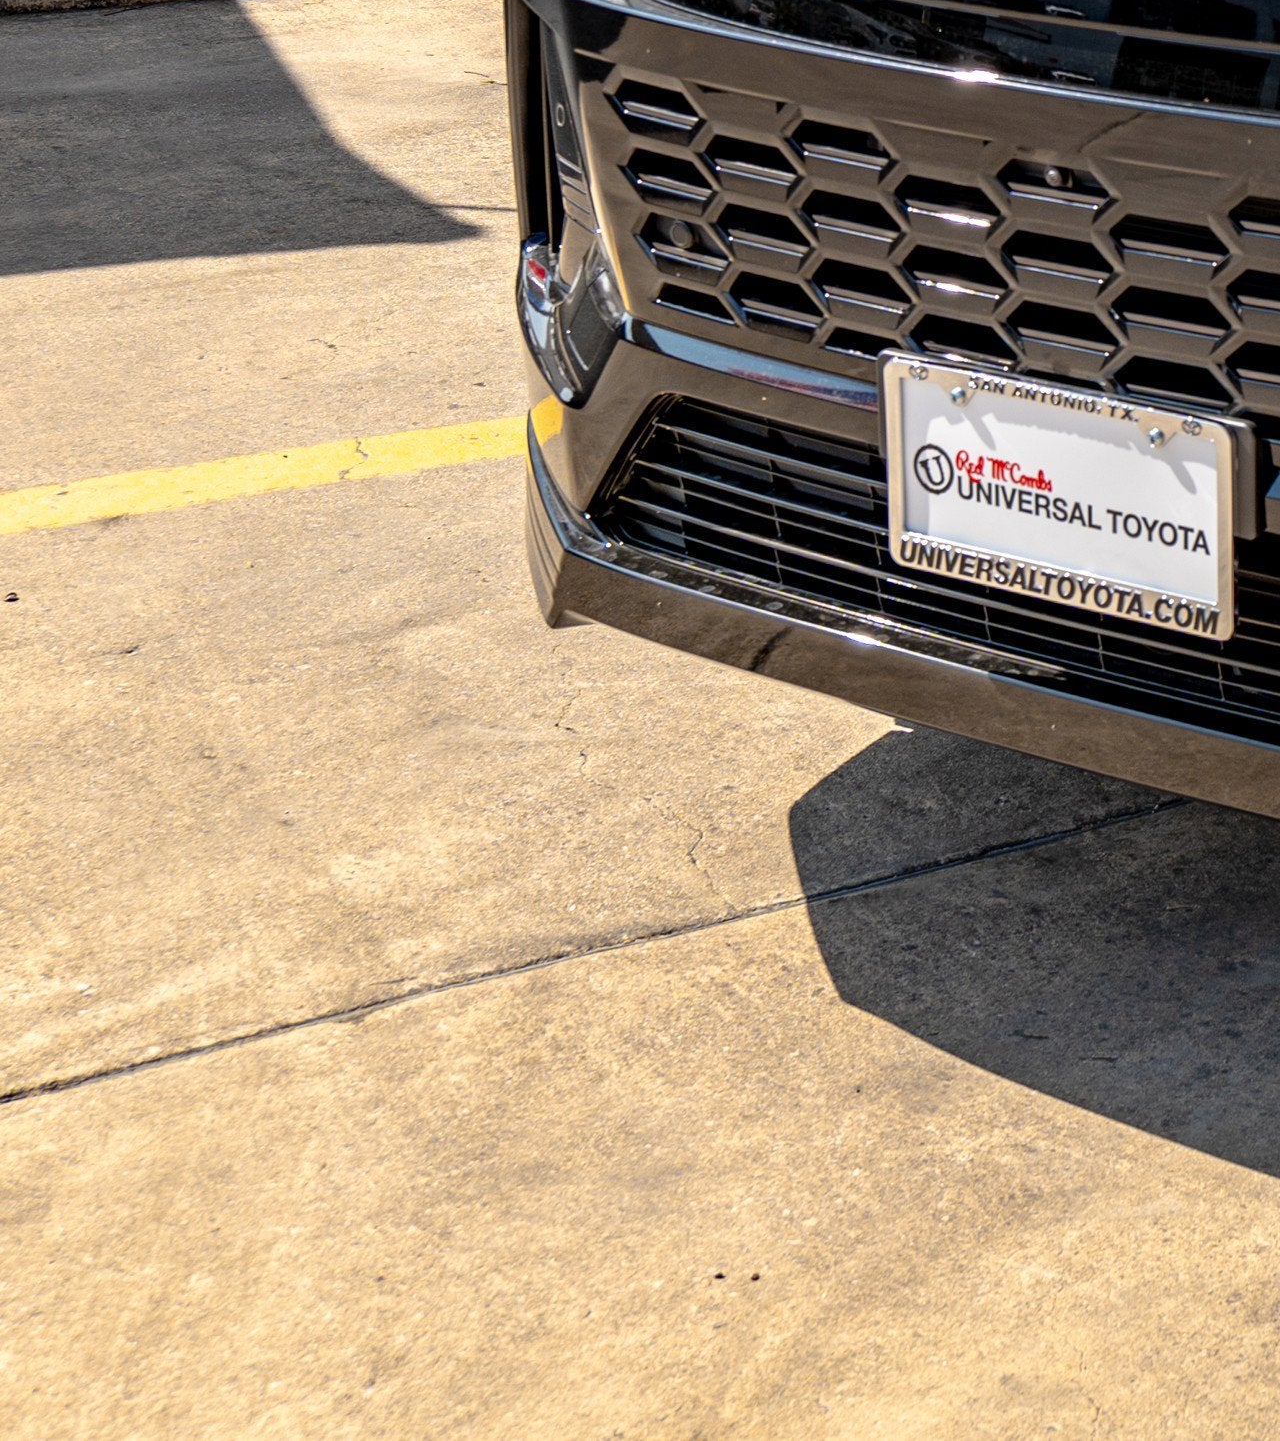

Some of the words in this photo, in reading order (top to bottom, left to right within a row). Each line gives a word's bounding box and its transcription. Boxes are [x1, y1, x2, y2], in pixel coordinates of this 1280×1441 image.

[967, 375, 1005, 396] SAN
[955, 450, 985, 482] Red
[987, 457, 1053, 492] McCombs
[957, 476, 1102, 531] UNIVERSAL
[1106, 509, 1211, 556] TOYOTA
[899, 536, 1221, 636] UNIVERSALTOYOTA.COM
